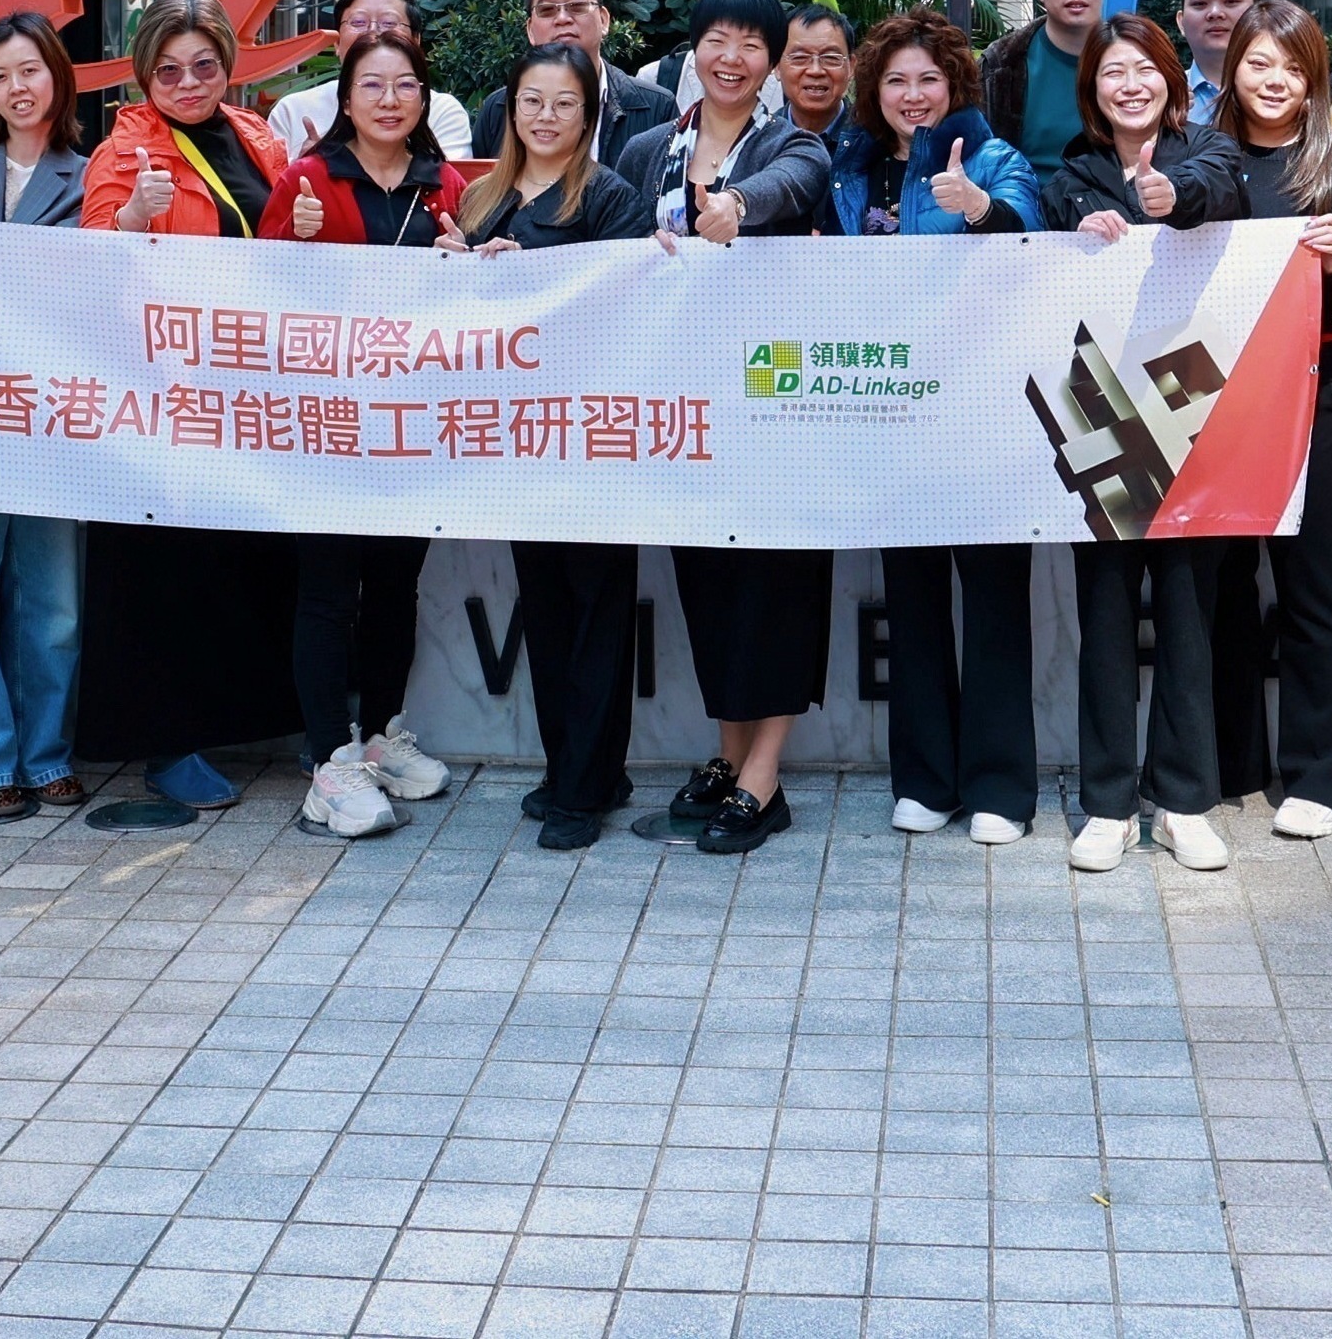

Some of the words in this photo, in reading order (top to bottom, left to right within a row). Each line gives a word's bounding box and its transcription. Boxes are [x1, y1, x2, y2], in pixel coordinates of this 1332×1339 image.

[143, 302, 541, 379] 阿里國際AITIC
[808, 375, 941, 400] AD-Linkage
